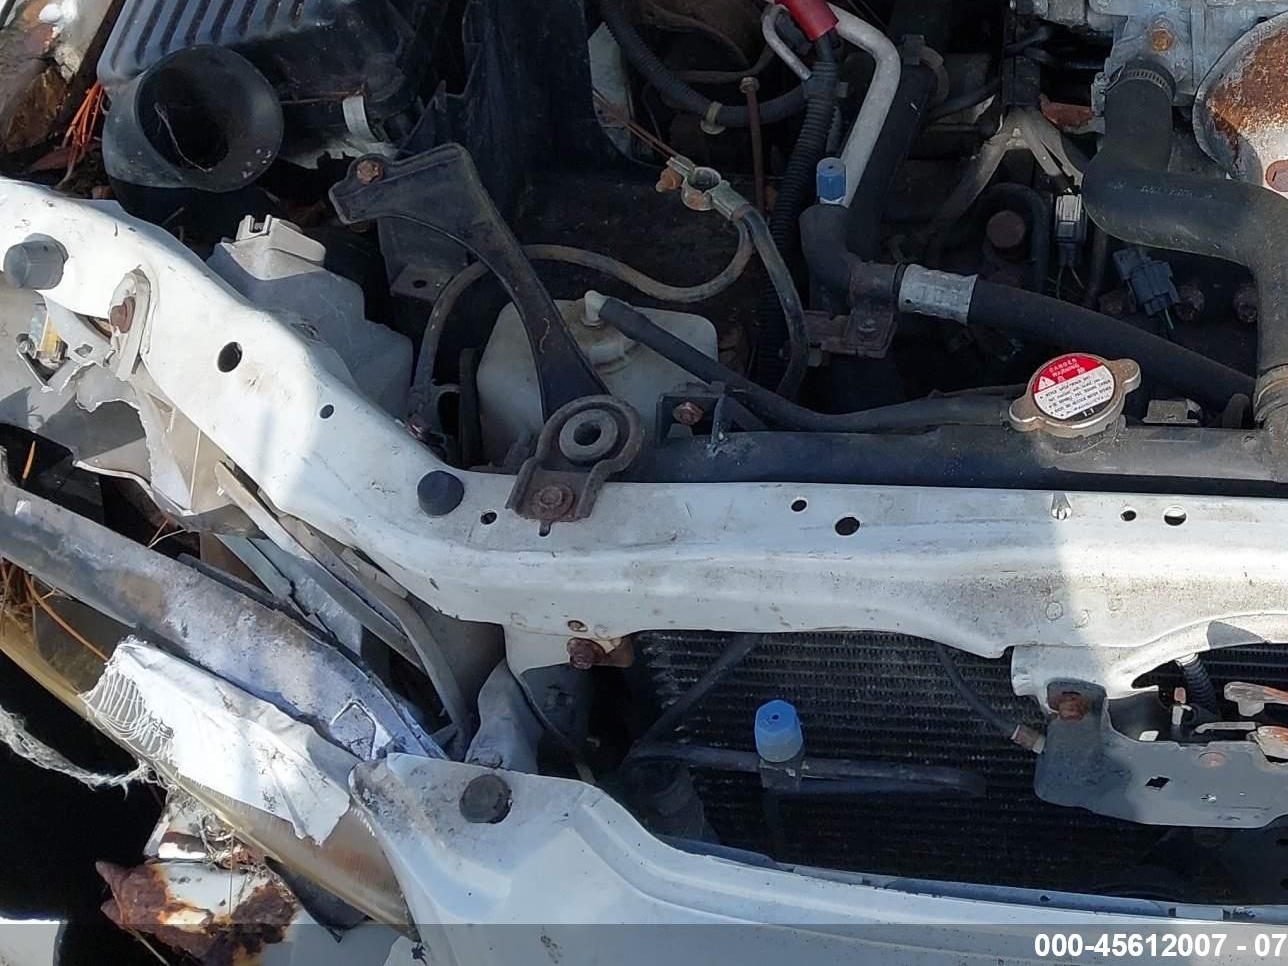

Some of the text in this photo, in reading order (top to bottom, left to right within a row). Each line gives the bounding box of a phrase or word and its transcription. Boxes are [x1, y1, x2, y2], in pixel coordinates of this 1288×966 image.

[1048, 357, 1078, 374] DANGER
[1051, 363, 1081, 379] WARNING
[1082, 407, 1095, 418] 1.1
